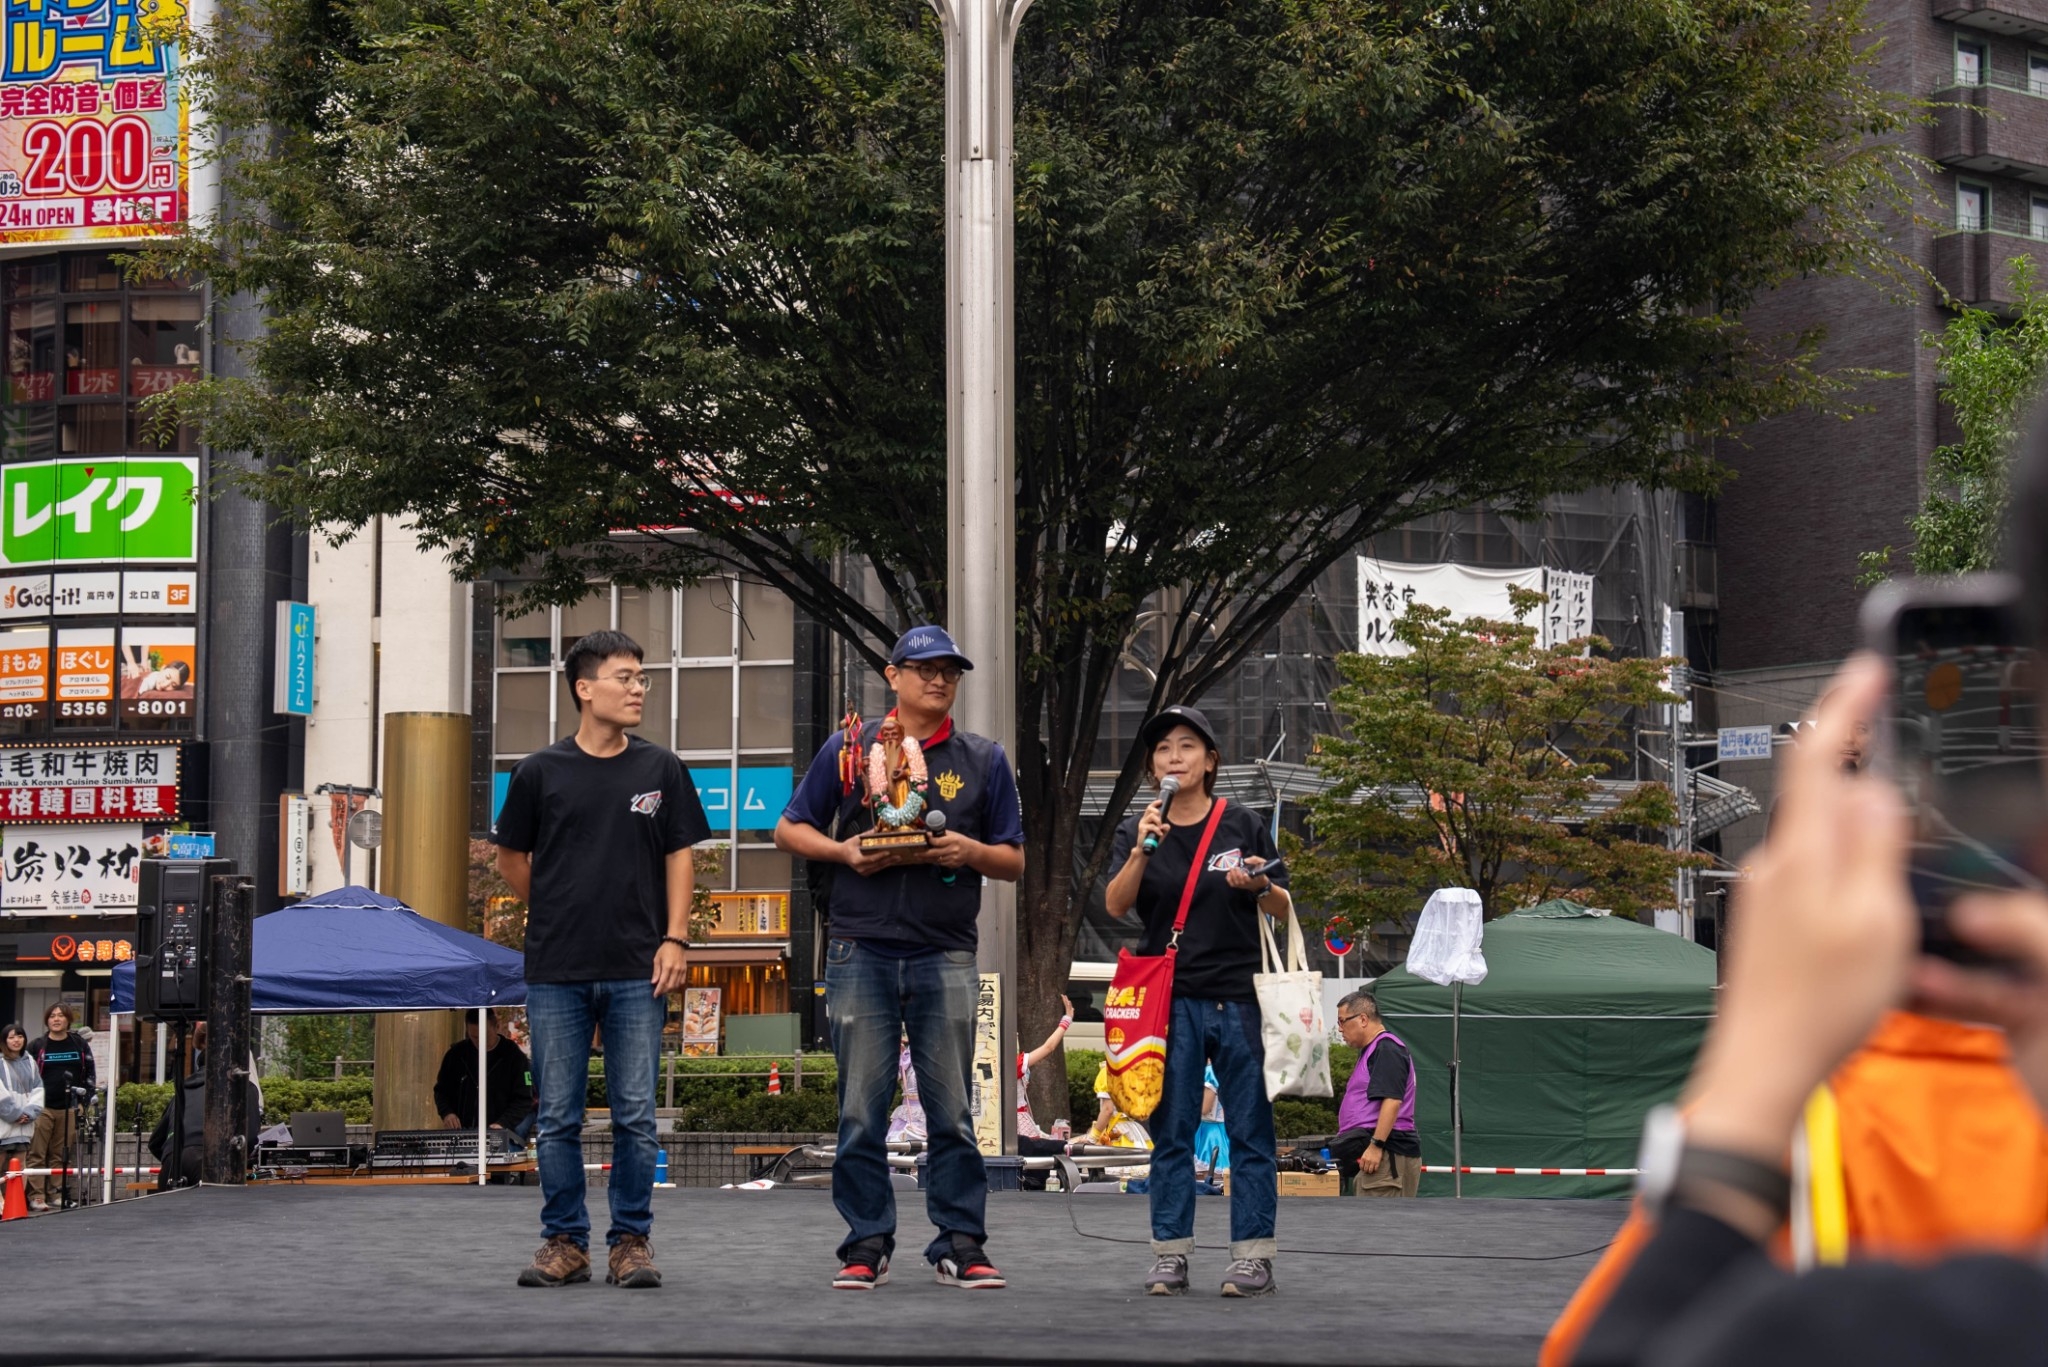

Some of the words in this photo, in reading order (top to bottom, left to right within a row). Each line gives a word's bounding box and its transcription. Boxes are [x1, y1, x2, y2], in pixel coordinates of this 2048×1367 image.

[12, 14, 156, 73] ルーム
[1, 80, 165, 117] 完全防音・個室
[0, 203, 32, 227] 24H
[36, 208, 75, 225] OPEN
[78, 372, 115, 394] レッド
[13, 477, 163, 537] レイク
[86, 591, 115, 600] 高円寺
[129, 591, 160, 600] 北口店
[170, 589, 187, 601] 3F
[60, 651, 110, 671] ほぐし
[296, 640, 306, 707] ハウスコム
[61, 701, 107, 716] 5356
[0, 750, 159, 778] 毛和牛焼肉
[22, 779, 29, 787] &
[31, 779, 64, 787] Korean
[66, 778, 100, 786] Cuisine
[102, 777, 158, 786] Sumibi-Mura
[0, 787, 159, 816] 格韓国料理
[5, 841, 138, 885] 炭火村
[1104, 1007, 1141, 1020] CRACKERS
